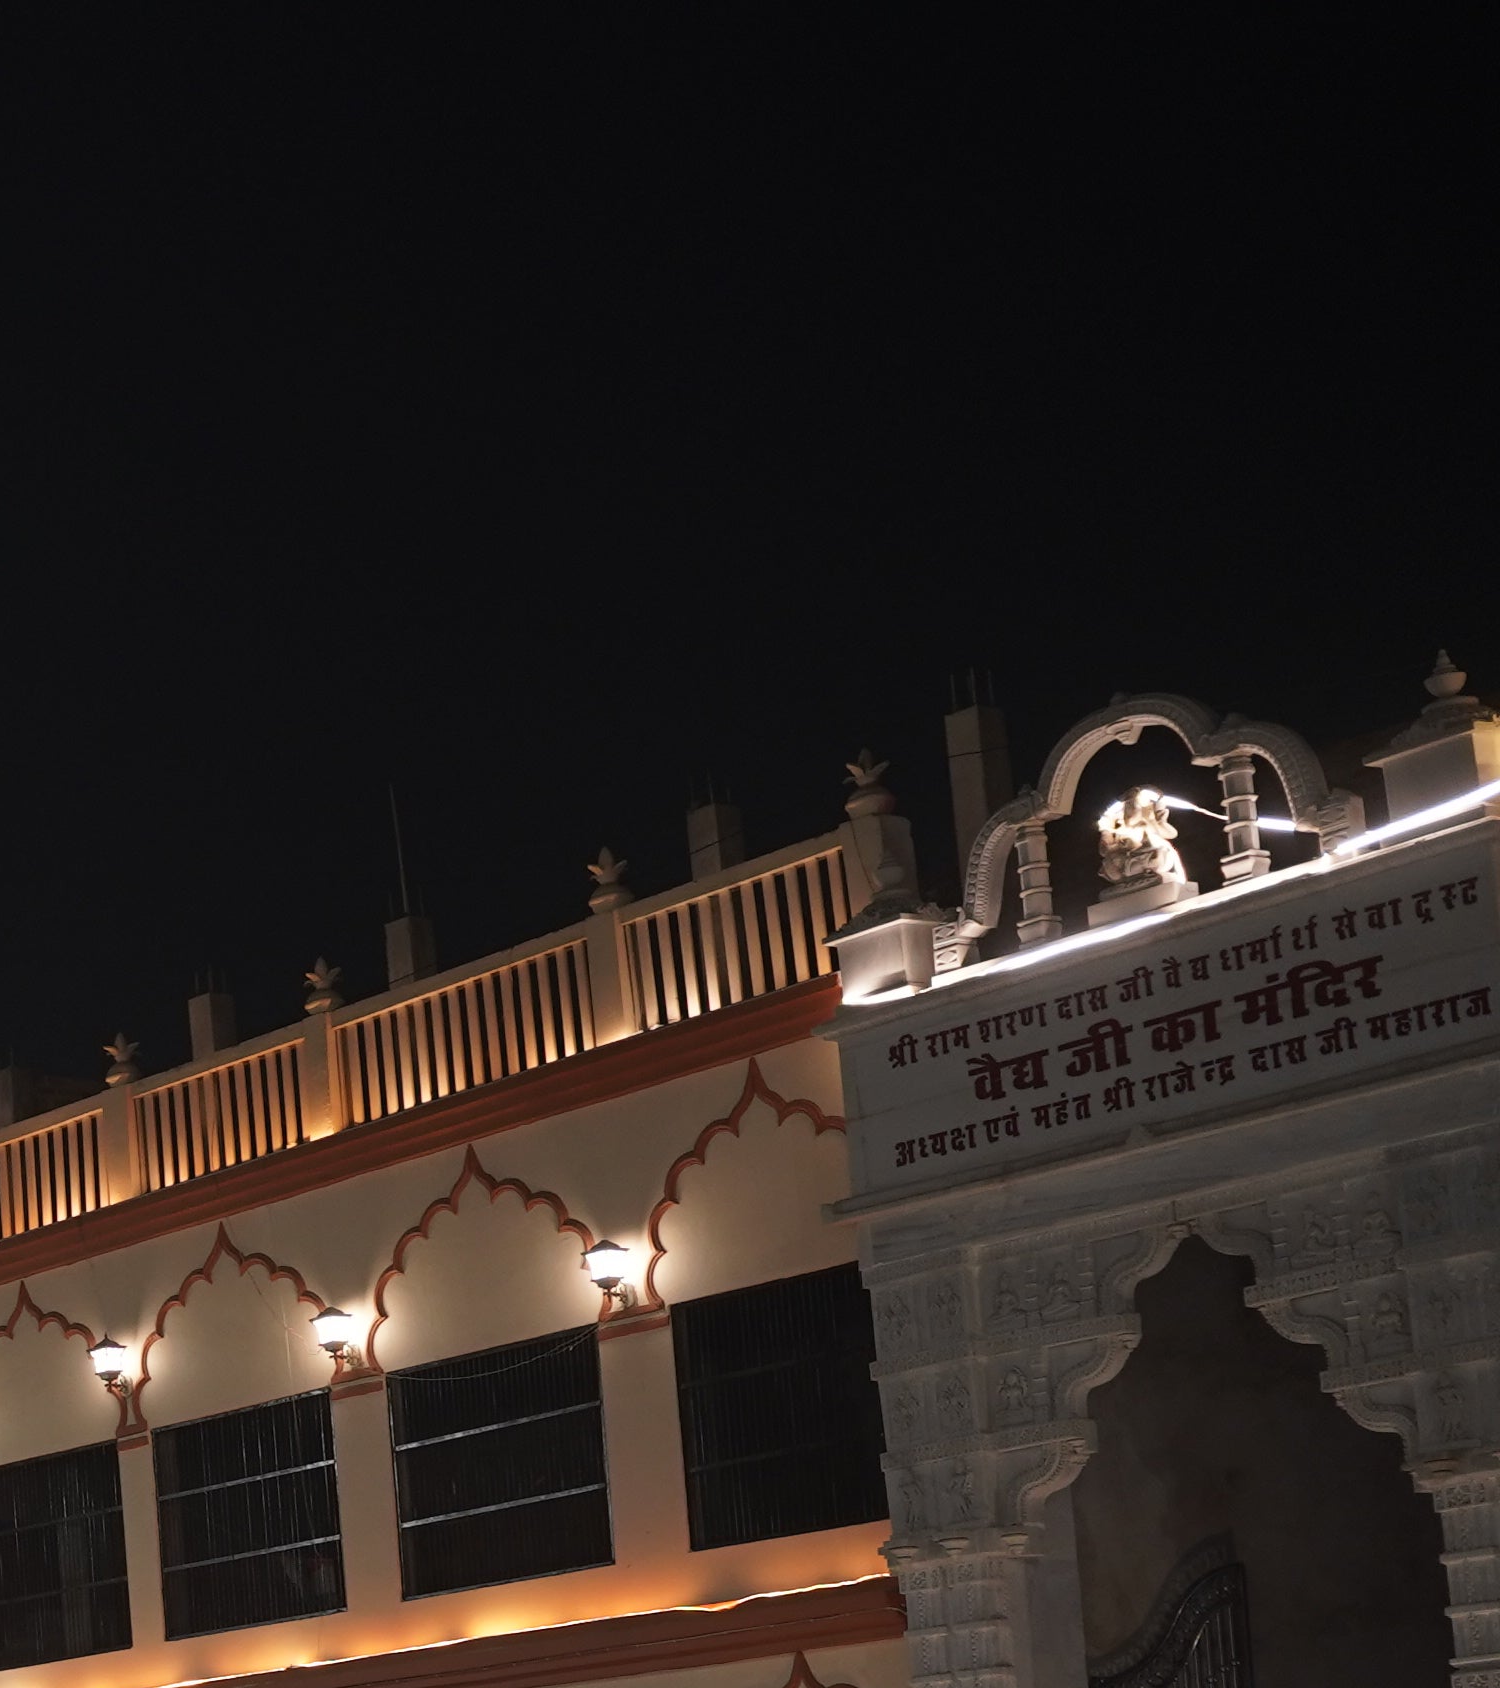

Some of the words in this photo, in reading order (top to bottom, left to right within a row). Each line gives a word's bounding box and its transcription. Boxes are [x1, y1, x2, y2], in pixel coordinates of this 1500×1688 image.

[888, 1033, 919, 1069] श्री
[925, 1024, 970, 1058] राम
[976, 1002, 1048, 1044] शरण
[1054, 984, 1107, 1020] दास
[1116, 966, 1155, 1003] जी
[1332, 897, 1403, 940] सेवा
[965, 1049, 1050, 1101] वैद्य
[1058, 1018, 1133, 1078] जी
[1144, 1000, 1222, 1052] का
[1234, 954, 1384, 1027] मंदिर
[894, 1123, 977, 1168] अध्यक्ष
[983, 1106, 1021, 1143] एवं
[1031, 1091, 1092, 1129] महंत
[1103, 1076, 1136, 1114] श्री
[1144, 1055, 1235, 1101] राजेन्द्र
[1248, 1035, 1307, 1073] दास
[1316, 1016, 1358, 1056] जी
[1366, 986, 1492, 1041] महाराज
